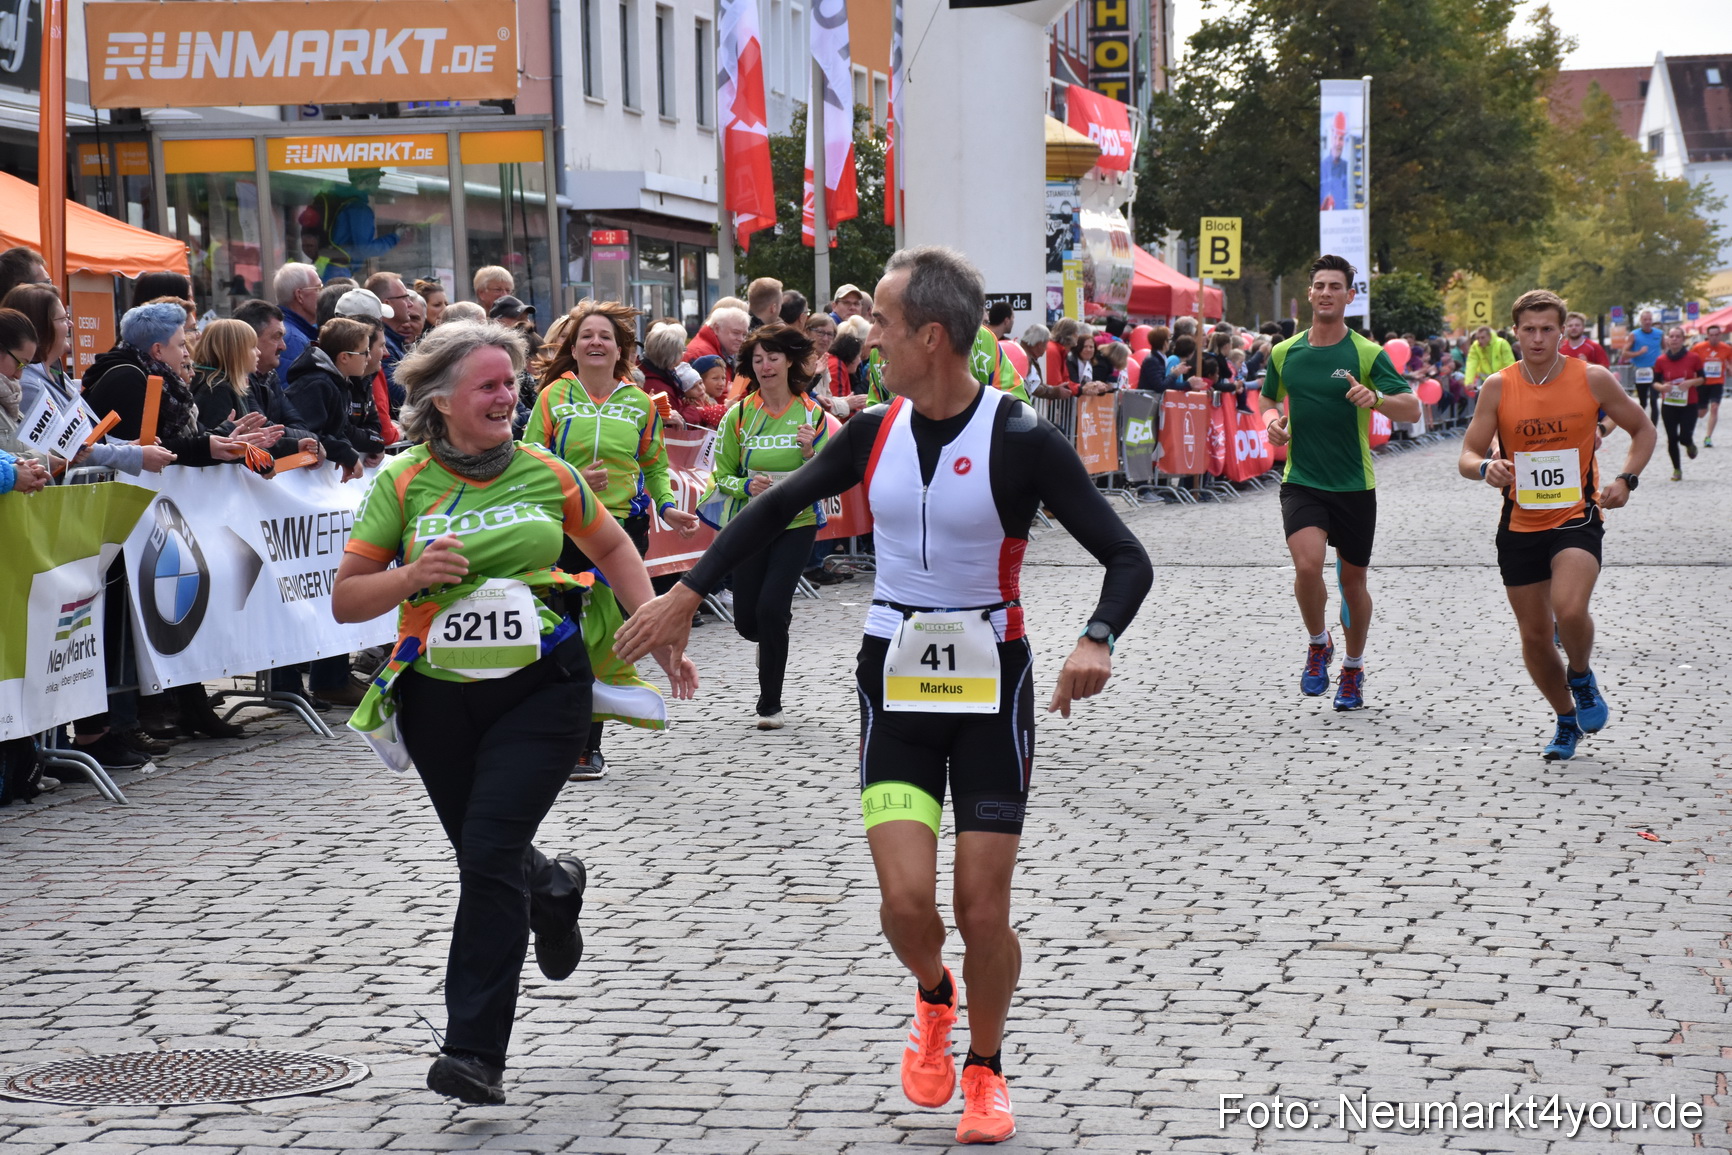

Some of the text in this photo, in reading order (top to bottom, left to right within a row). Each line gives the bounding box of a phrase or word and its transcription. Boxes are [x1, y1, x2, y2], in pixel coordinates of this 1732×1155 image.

[103, 27, 497, 80] RUNMARKT.DE
[285, 142, 433, 164] RUNMARKT.DE
[1206, 221, 1236, 231] Block
[1211, 236, 1230, 264] B
[1474, 301, 1485, 318] C
[29, 410, 52, 443] swn
[551, 402, 646, 427] BOCK
[58, 417, 81, 449] swn
[1523, 421, 1567, 437] OEXL
[1531, 469, 1564, 486] 105
[415, 502, 552, 542] BOCK
[260, 515, 313, 562] BMW
[276, 571, 321, 603] WENIGER
[443, 610, 522, 641] 5215
[925, 622, 964, 631] BOCK
[442, 648, 510, 665] ANKE
[920, 643, 955, 671] 41
[920, 682, 963, 694] Markus
